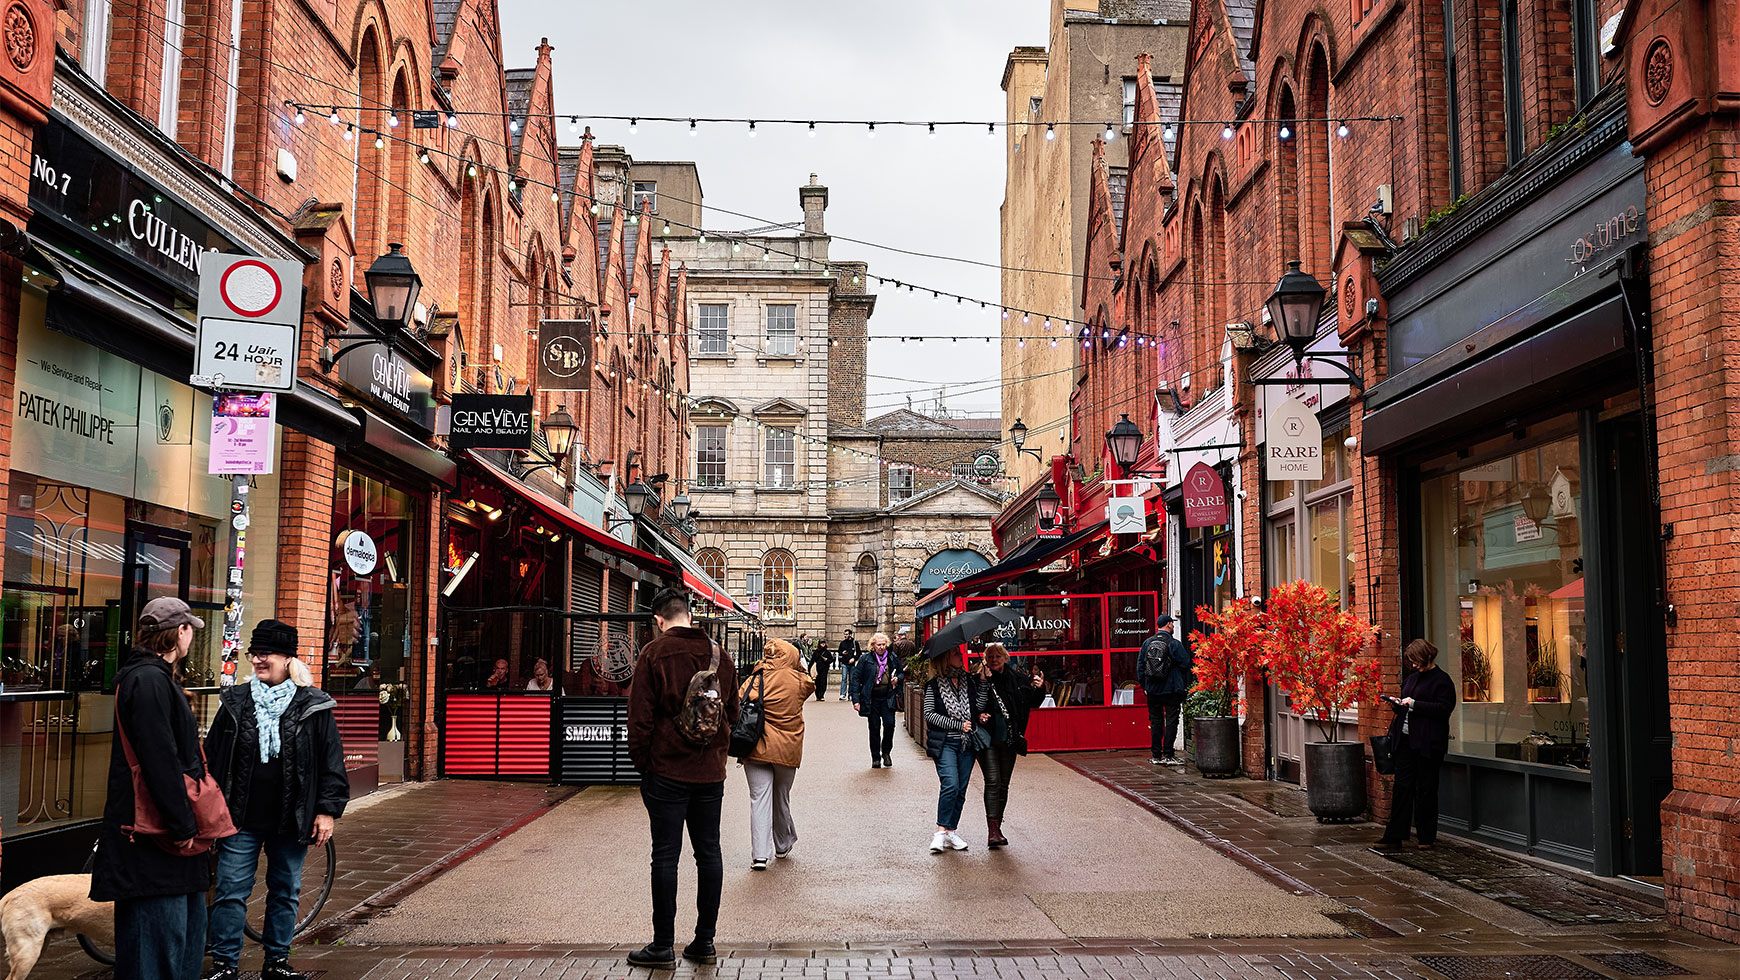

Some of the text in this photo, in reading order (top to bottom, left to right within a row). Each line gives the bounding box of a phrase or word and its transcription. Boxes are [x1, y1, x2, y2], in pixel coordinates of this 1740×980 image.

[61, 173, 72, 196] 7
[128, 199, 201, 276] CULLEN
[213, 341, 278, 362] 24 Uair
[40, 359, 102, 391] We Service and Repair
[370, 382, 410, 414] NAIL AND BEAUTY
[18, 390, 115, 445] PATEK PHILIPPE
[1290, 422, 1298, 431] R
[1270, 446, 1318, 458] RARE
[1280, 463, 1309, 472] HOME
[1198, 477, 1208, 486] R
[1185, 495, 1225, 509] RARE
[1190, 510, 1222, 518] JEWELLERY
[346, 545, 376, 562] dermalogica
[565, 726, 612, 742] SMOKIN
